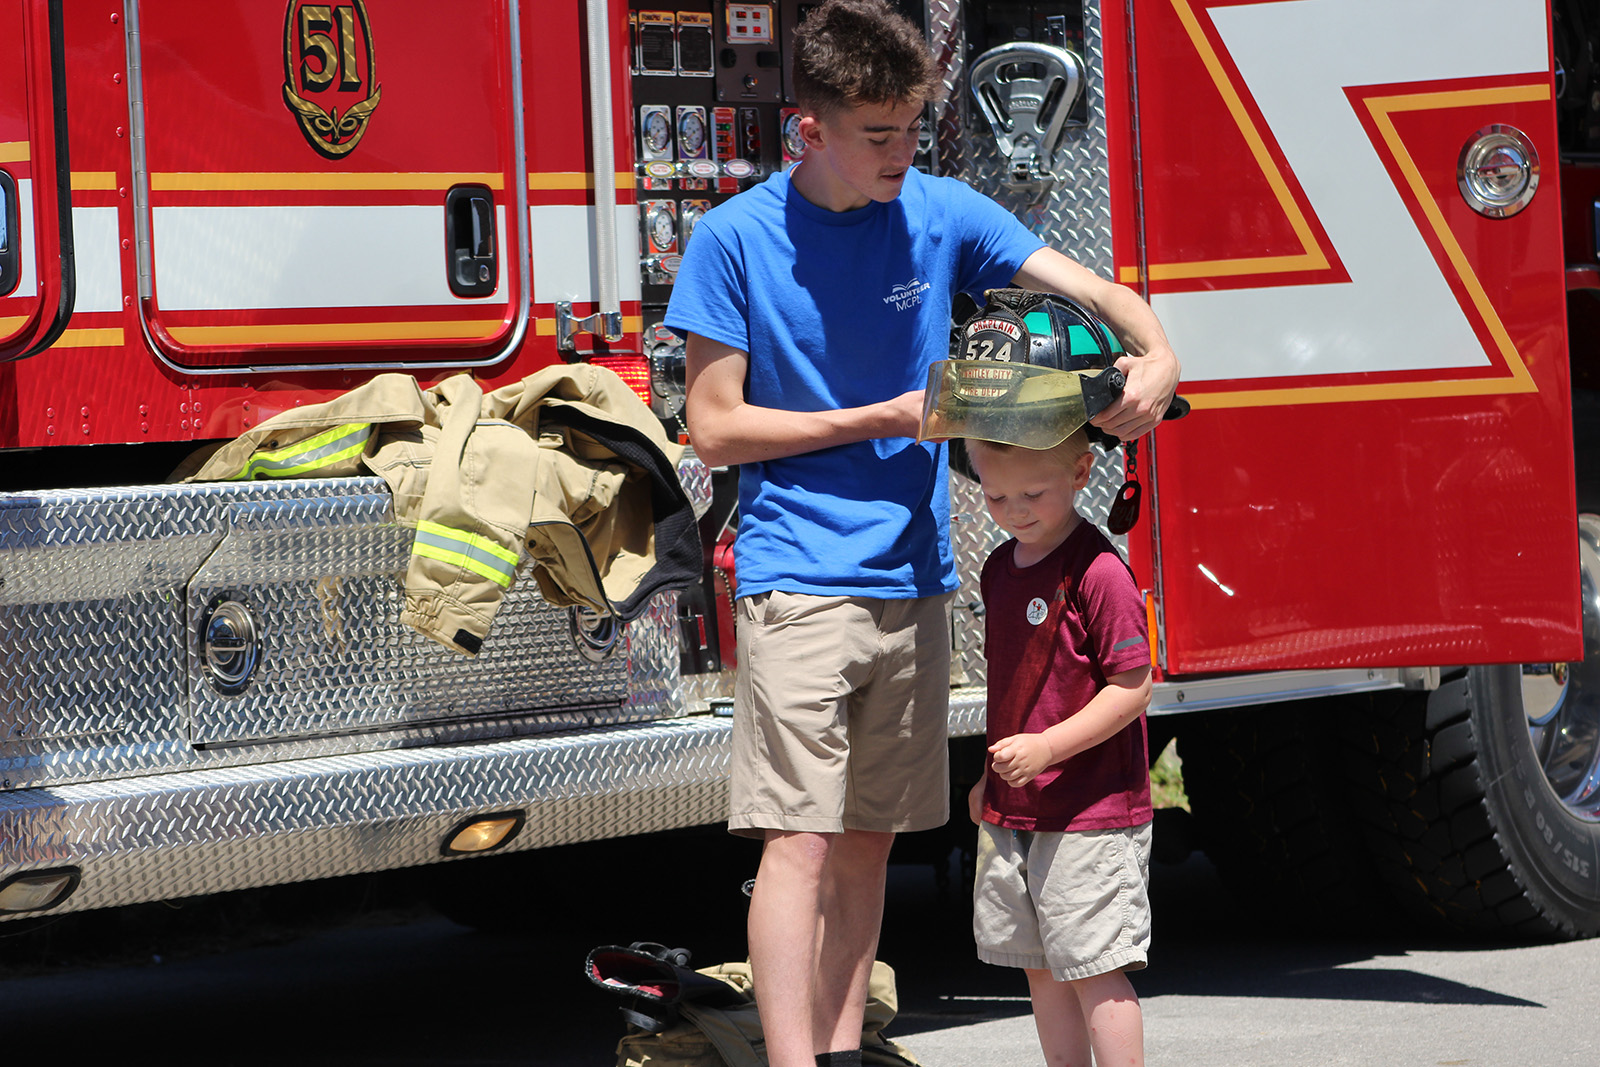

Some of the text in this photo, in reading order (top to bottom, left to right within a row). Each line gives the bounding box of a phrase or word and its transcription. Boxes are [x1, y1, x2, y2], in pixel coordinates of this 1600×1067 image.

[298, 4, 362, 93] 51
[883, 282, 931, 304] VOLUNTEER
[973, 319, 1015, 335] CHAPLAIN
[965, 340, 1013, 363] 524
[992, 369, 1012, 380] CITY
[964, 386, 979, 397] FIRE
